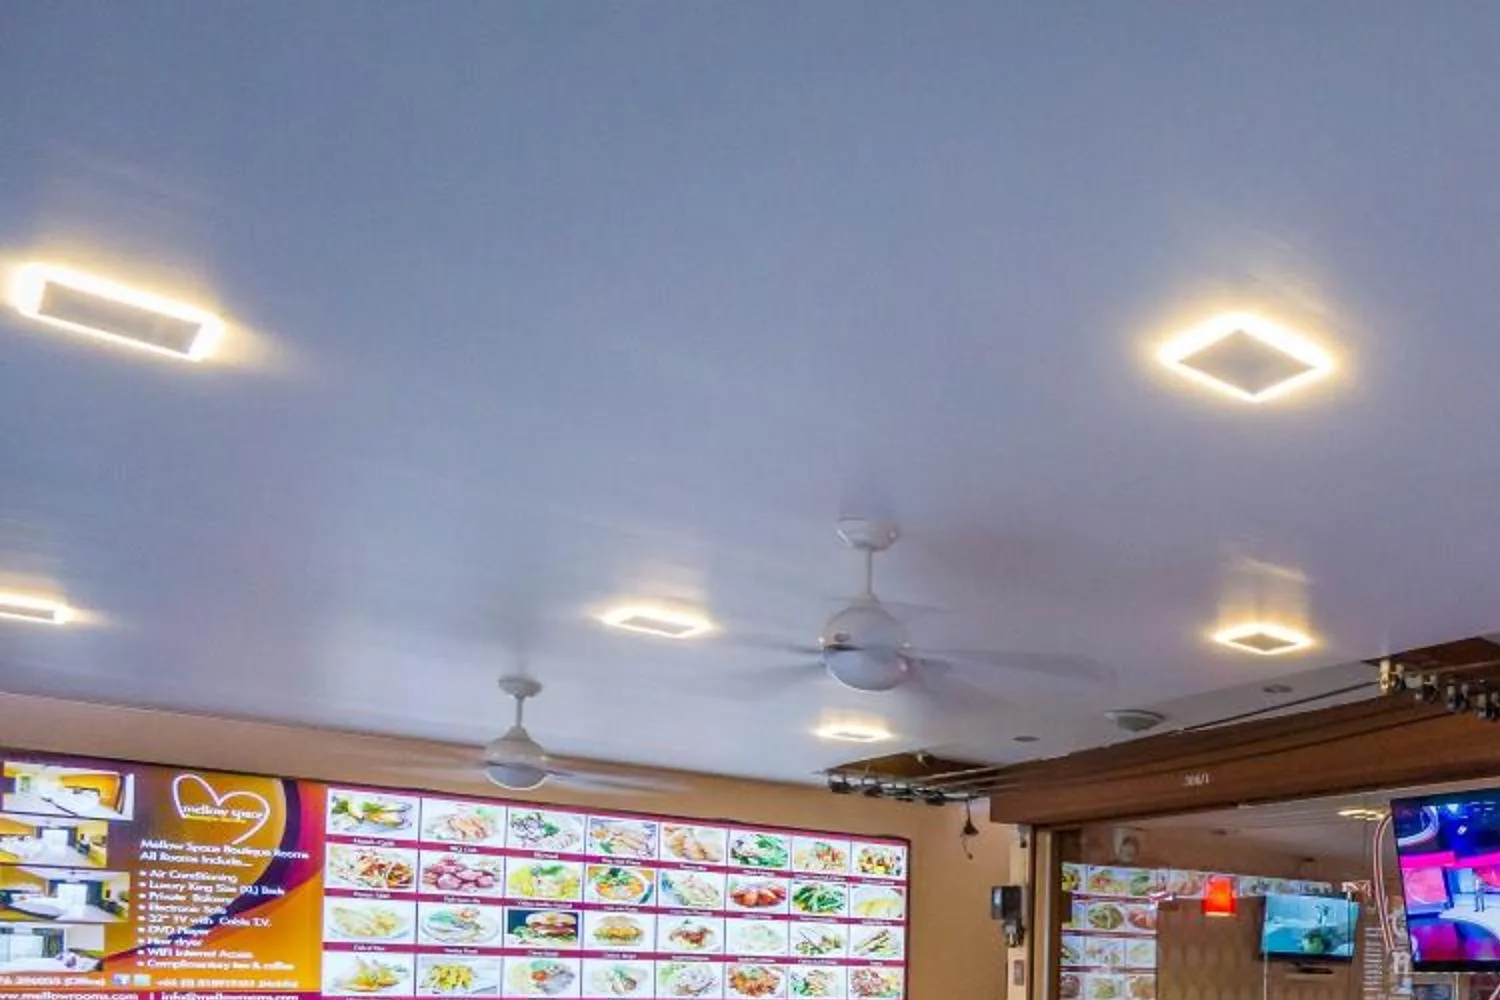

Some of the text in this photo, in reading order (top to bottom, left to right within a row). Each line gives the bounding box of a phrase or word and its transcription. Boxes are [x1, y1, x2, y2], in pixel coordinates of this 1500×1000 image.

[140, 840, 184, 850] Mellow
[186, 843, 221, 854] Space
[149, 869, 238, 884] Air Conditioning
[148, 926, 174, 935] DVD
